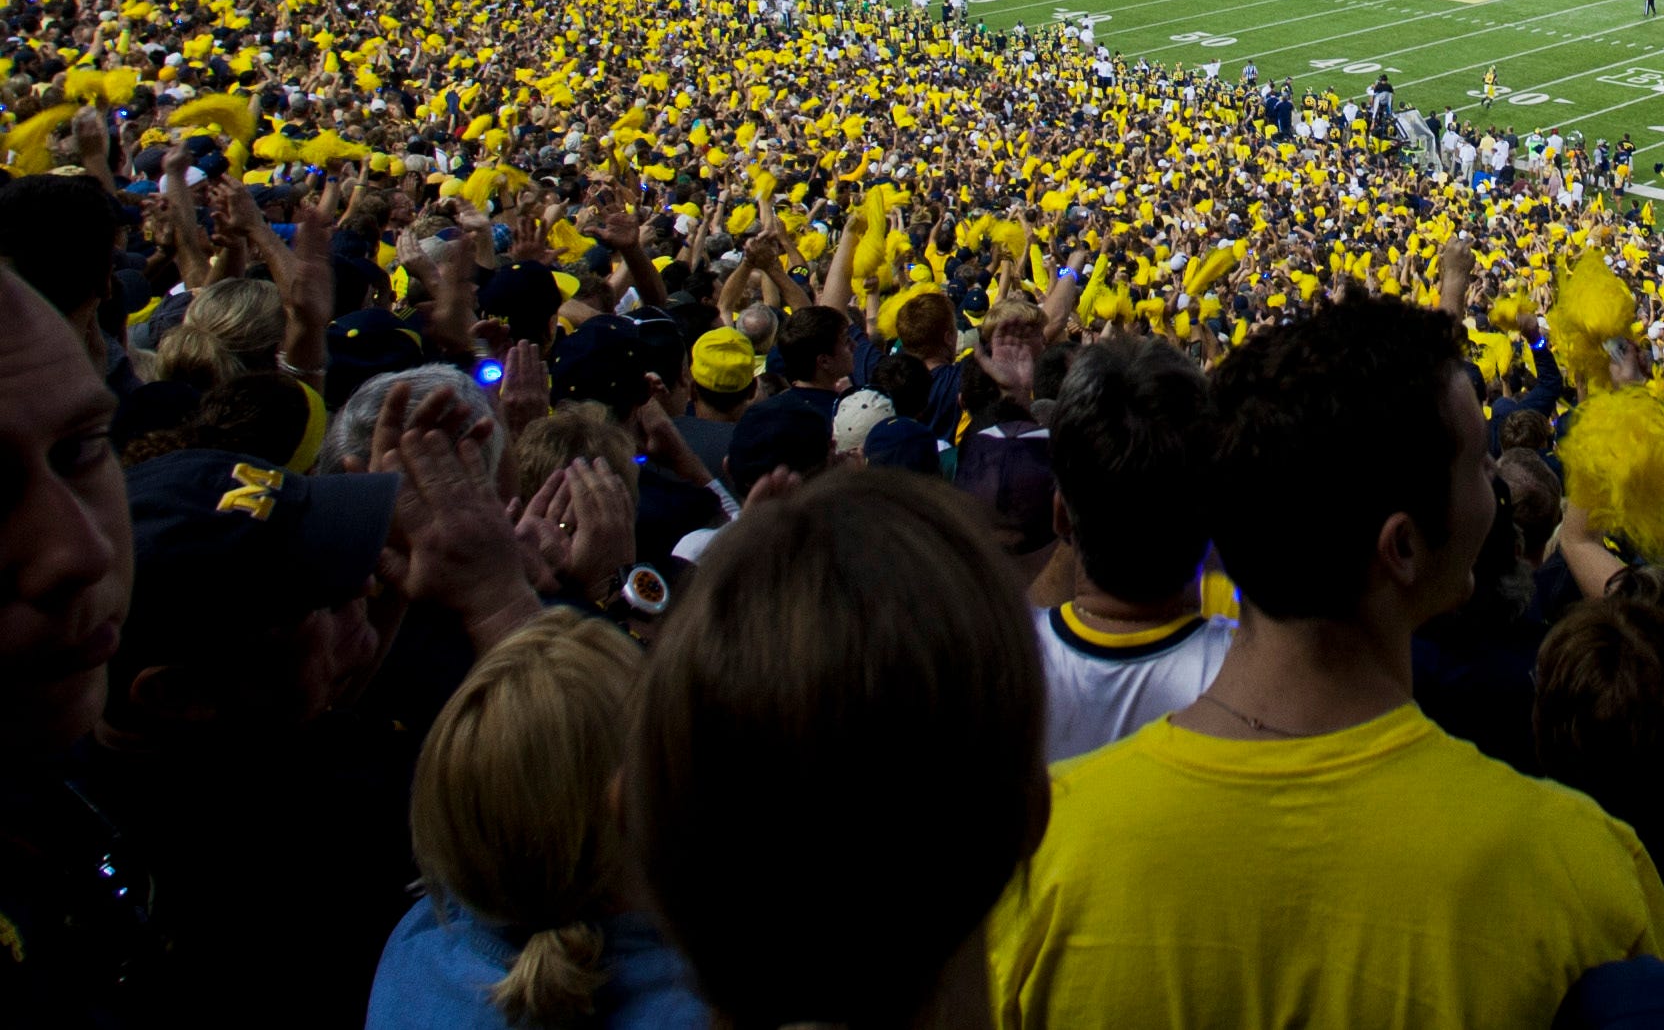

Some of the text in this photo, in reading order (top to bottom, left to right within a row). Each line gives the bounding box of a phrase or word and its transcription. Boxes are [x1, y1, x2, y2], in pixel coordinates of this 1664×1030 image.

[1169, 31, 1239, 47] 50
[1309, 57, 1382, 74] 40
[217, 463, 284, 522] M
